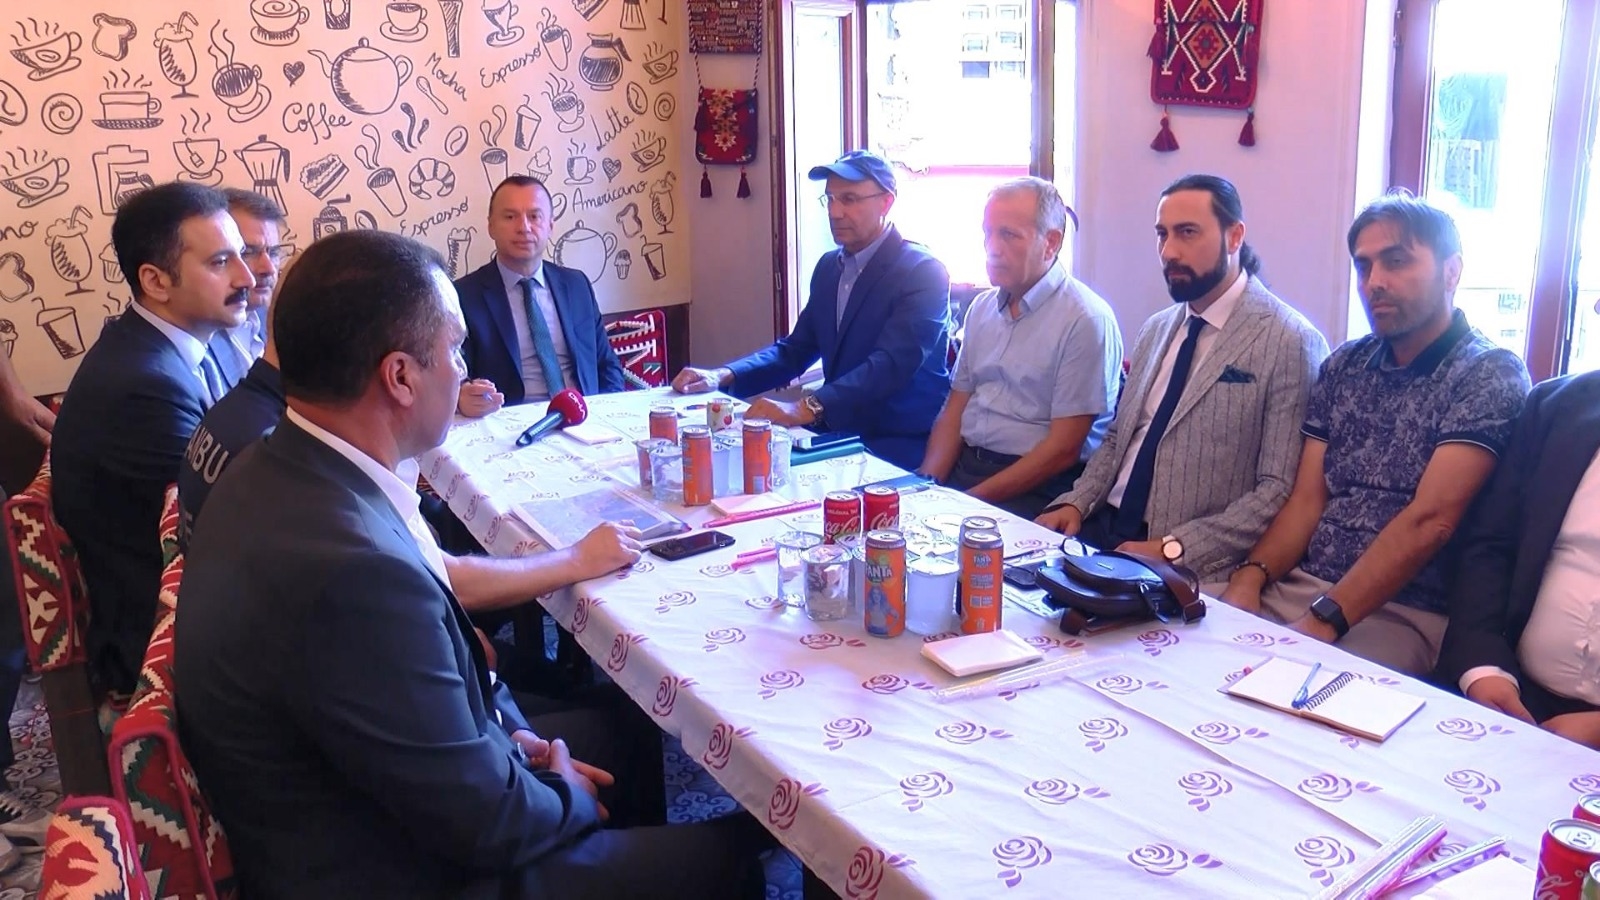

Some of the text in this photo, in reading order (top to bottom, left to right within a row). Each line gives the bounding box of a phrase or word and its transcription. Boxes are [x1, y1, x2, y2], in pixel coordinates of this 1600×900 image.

[425, 52, 467, 102] Mocha
[480, 41, 541, 88] Espresso
[282, 102, 353, 145] Coffee
[590, 106, 635, 152] Latte
[572, 180, 647, 213] Americano
